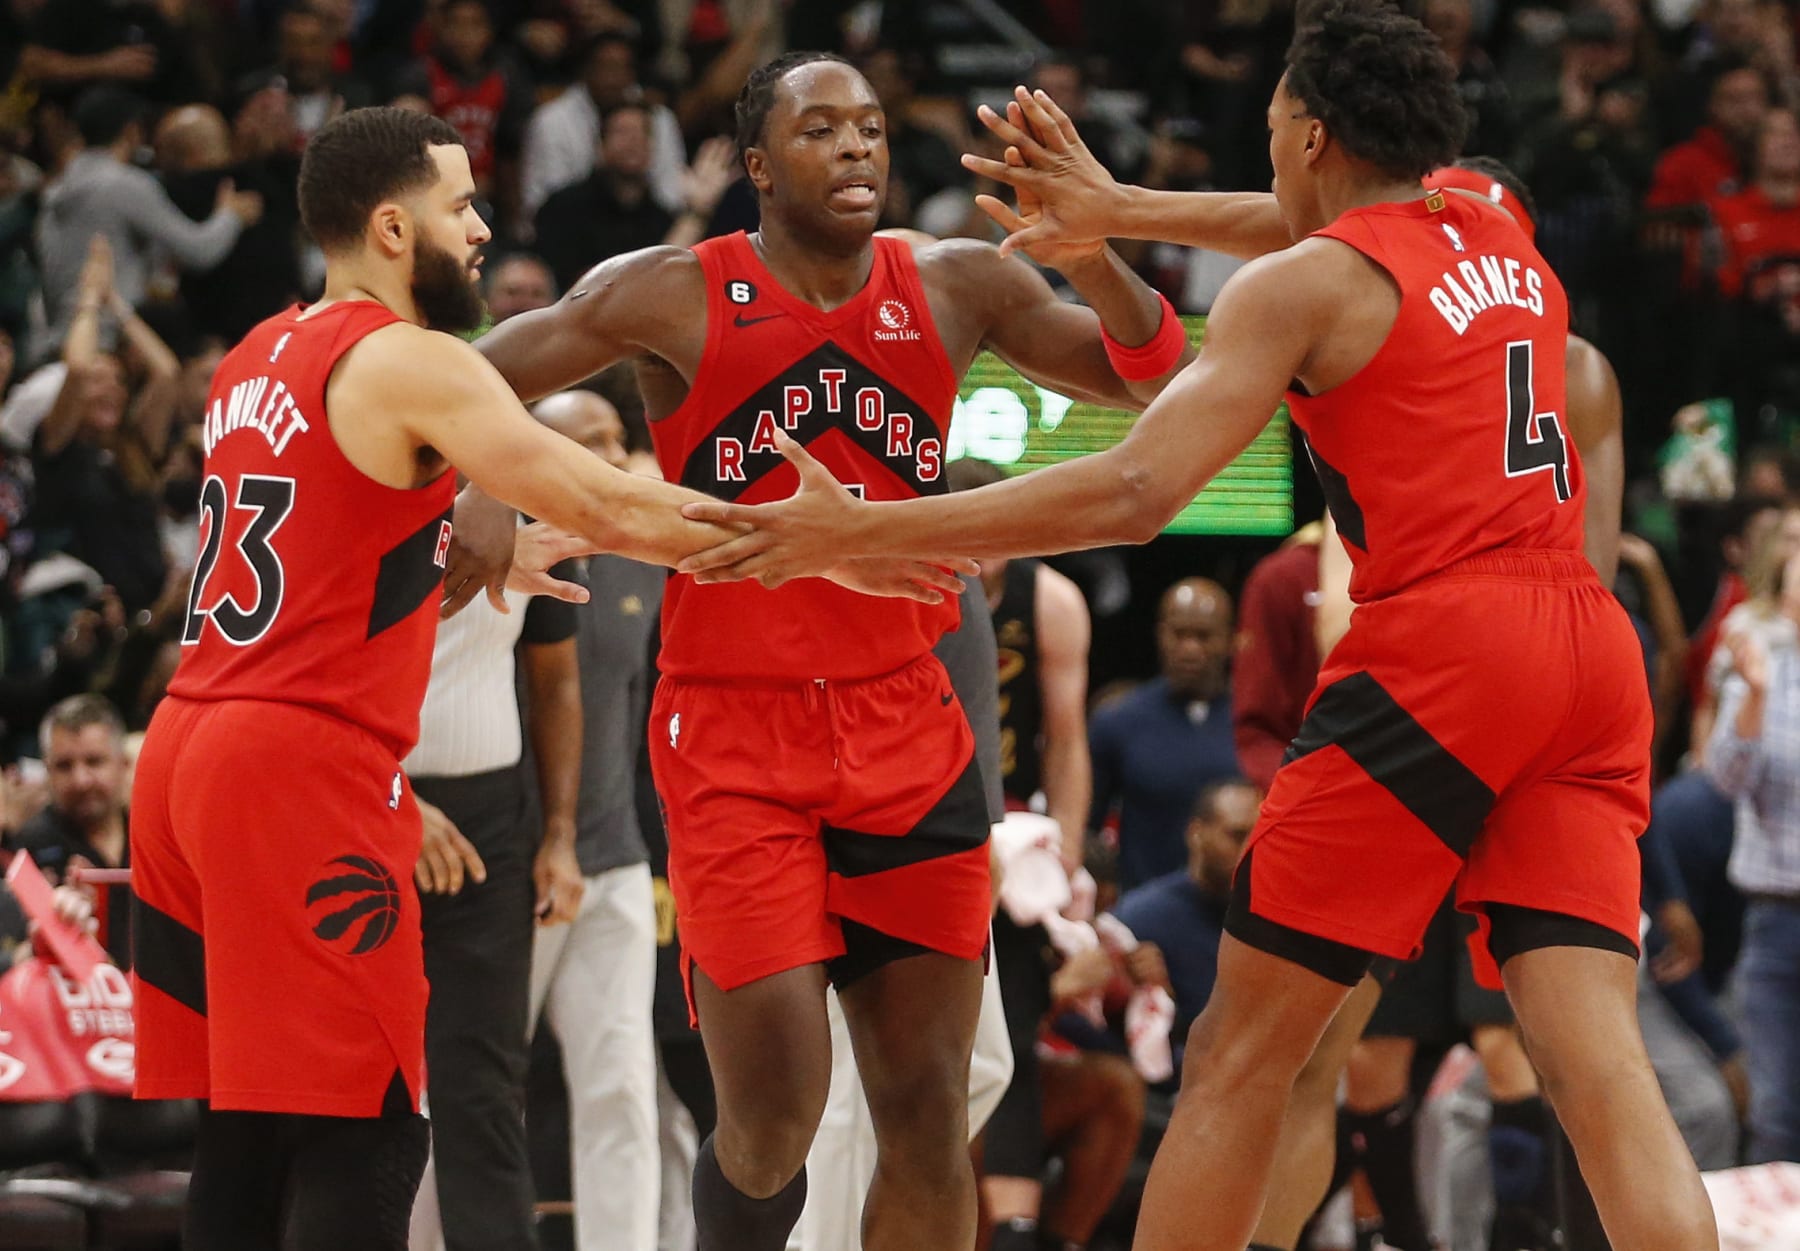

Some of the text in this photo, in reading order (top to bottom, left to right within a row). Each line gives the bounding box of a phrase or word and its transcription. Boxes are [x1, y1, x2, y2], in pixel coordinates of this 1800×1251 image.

[731, 281, 751, 303] 6
[874, 329, 921, 341] Sun Life
[1428, 255, 1544, 336] BARNES
[716, 368, 941, 482] RAPTORS
[1505, 339, 1573, 504] 4
[180, 474, 296, 646] 23
